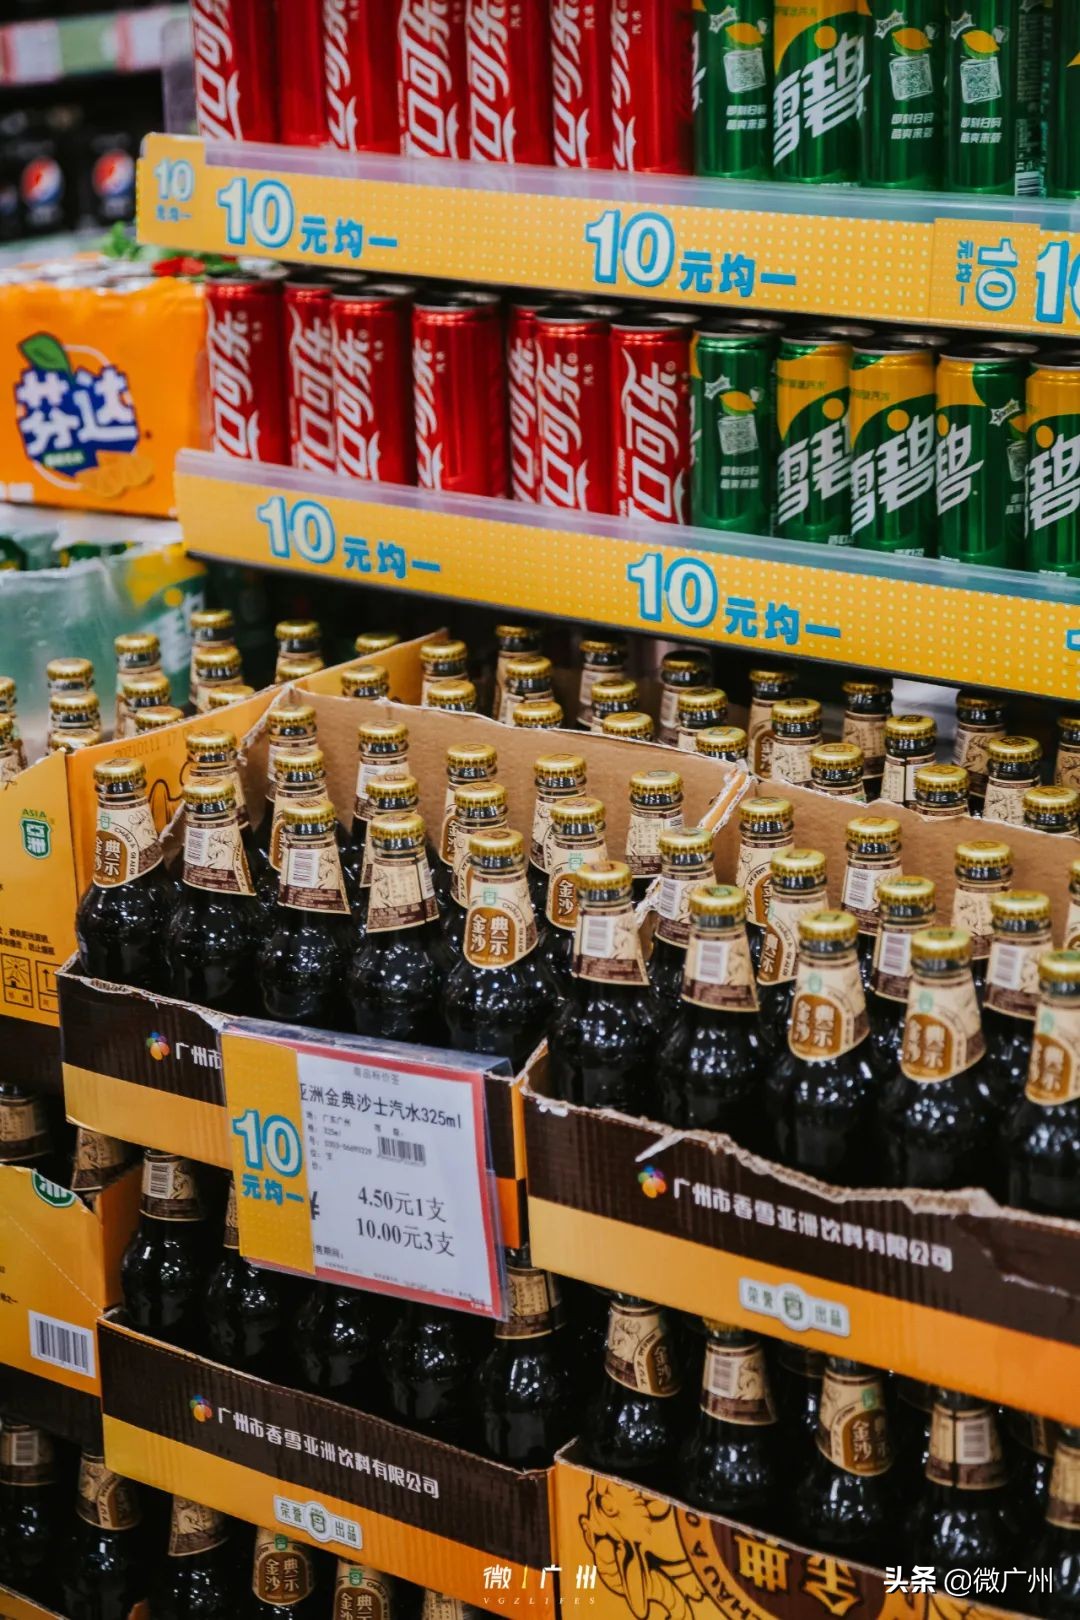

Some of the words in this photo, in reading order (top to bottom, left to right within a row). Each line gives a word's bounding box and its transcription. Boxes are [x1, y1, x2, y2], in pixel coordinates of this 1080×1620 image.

[774, 32, 871, 167] 雪碧
[154, 158, 195, 202] 10
[956, 240, 974, 306] 元均一
[975, 236, 1018, 312] 10
[1036, 239, 1080, 324] 1
[16, 366, 139, 457] 芬达
[850, 413, 936, 536] 雪碧
[1024, 433, 1080, 540] 碧
[232, 1109, 303, 1177] 10
[242, 1173, 305, 1206] 元均一
[357, 1185, 447, 1224] 4.50元1支
[674, 1177, 953, 1272] 广州市香雪亚洲饮料有限公司
[313, 1243, 344, 1260] 售期间：
[356, 1217, 455, 1258] 10.00元3支
[217, 1407, 440, 1499] 广州市香雪亚洲饮料有限公司
